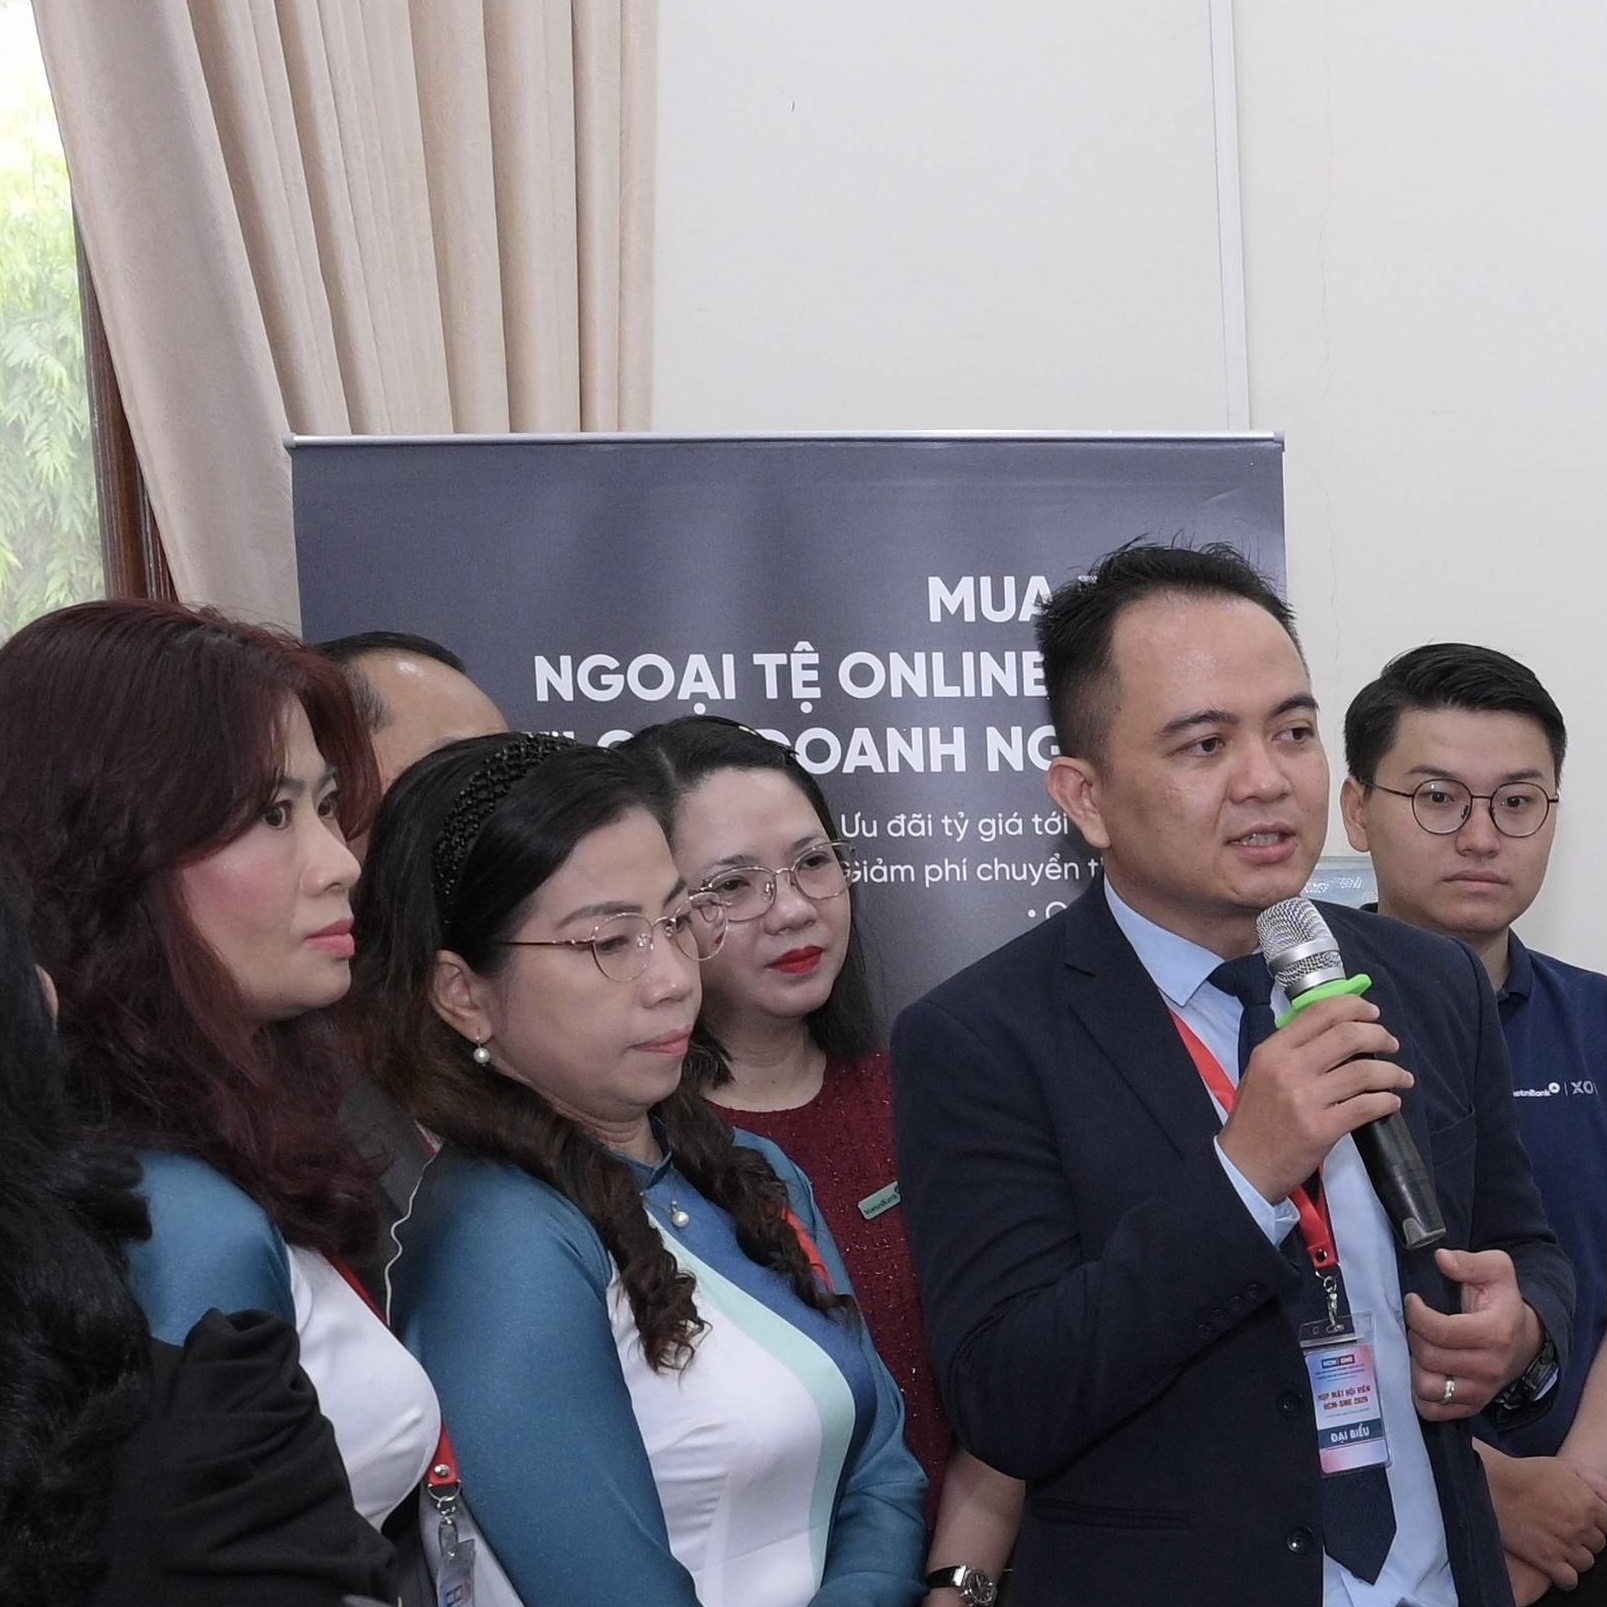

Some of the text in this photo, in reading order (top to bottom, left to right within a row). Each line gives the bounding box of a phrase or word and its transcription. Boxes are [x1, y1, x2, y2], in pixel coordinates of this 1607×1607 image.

[929, 576, 1054, 622] MUA
[535, 640, 1050, 715] NGOẠI TỆ ONLINE
[840, 811, 1069, 842] Ưu đãi tỷ giá tới
[924, 857, 968, 888] phí
[976, 852, 1080, 887] chuyển
